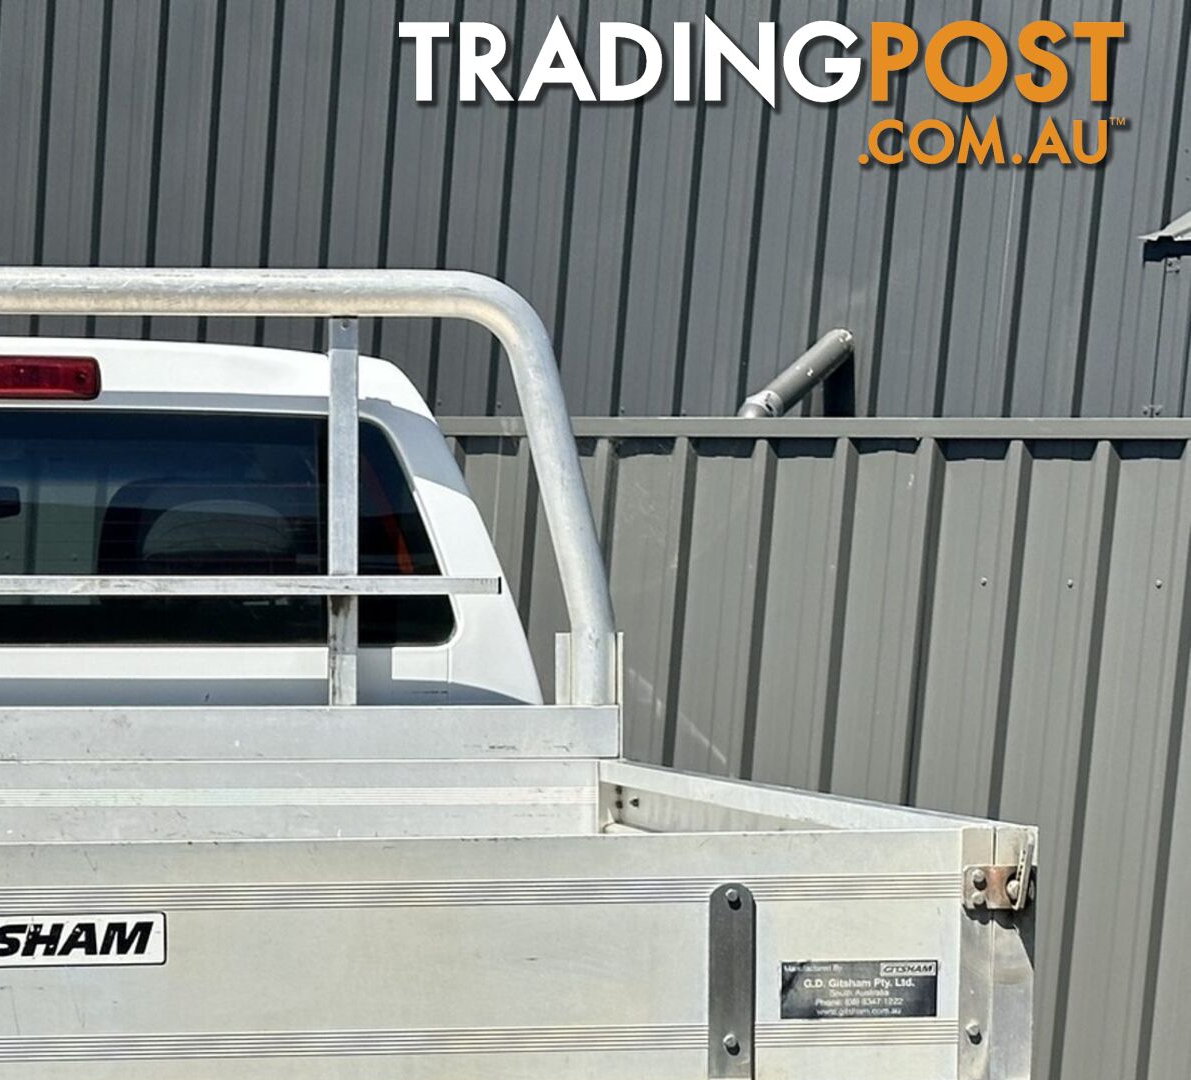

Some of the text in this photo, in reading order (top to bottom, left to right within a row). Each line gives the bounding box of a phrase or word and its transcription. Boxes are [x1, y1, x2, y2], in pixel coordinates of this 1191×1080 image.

[828, 977, 871, 988] Gitsham
[873, 977, 893, 990] Pty.
[895, 976, 915, 987] Ltd.
[855, 988, 890, 997] Australia
